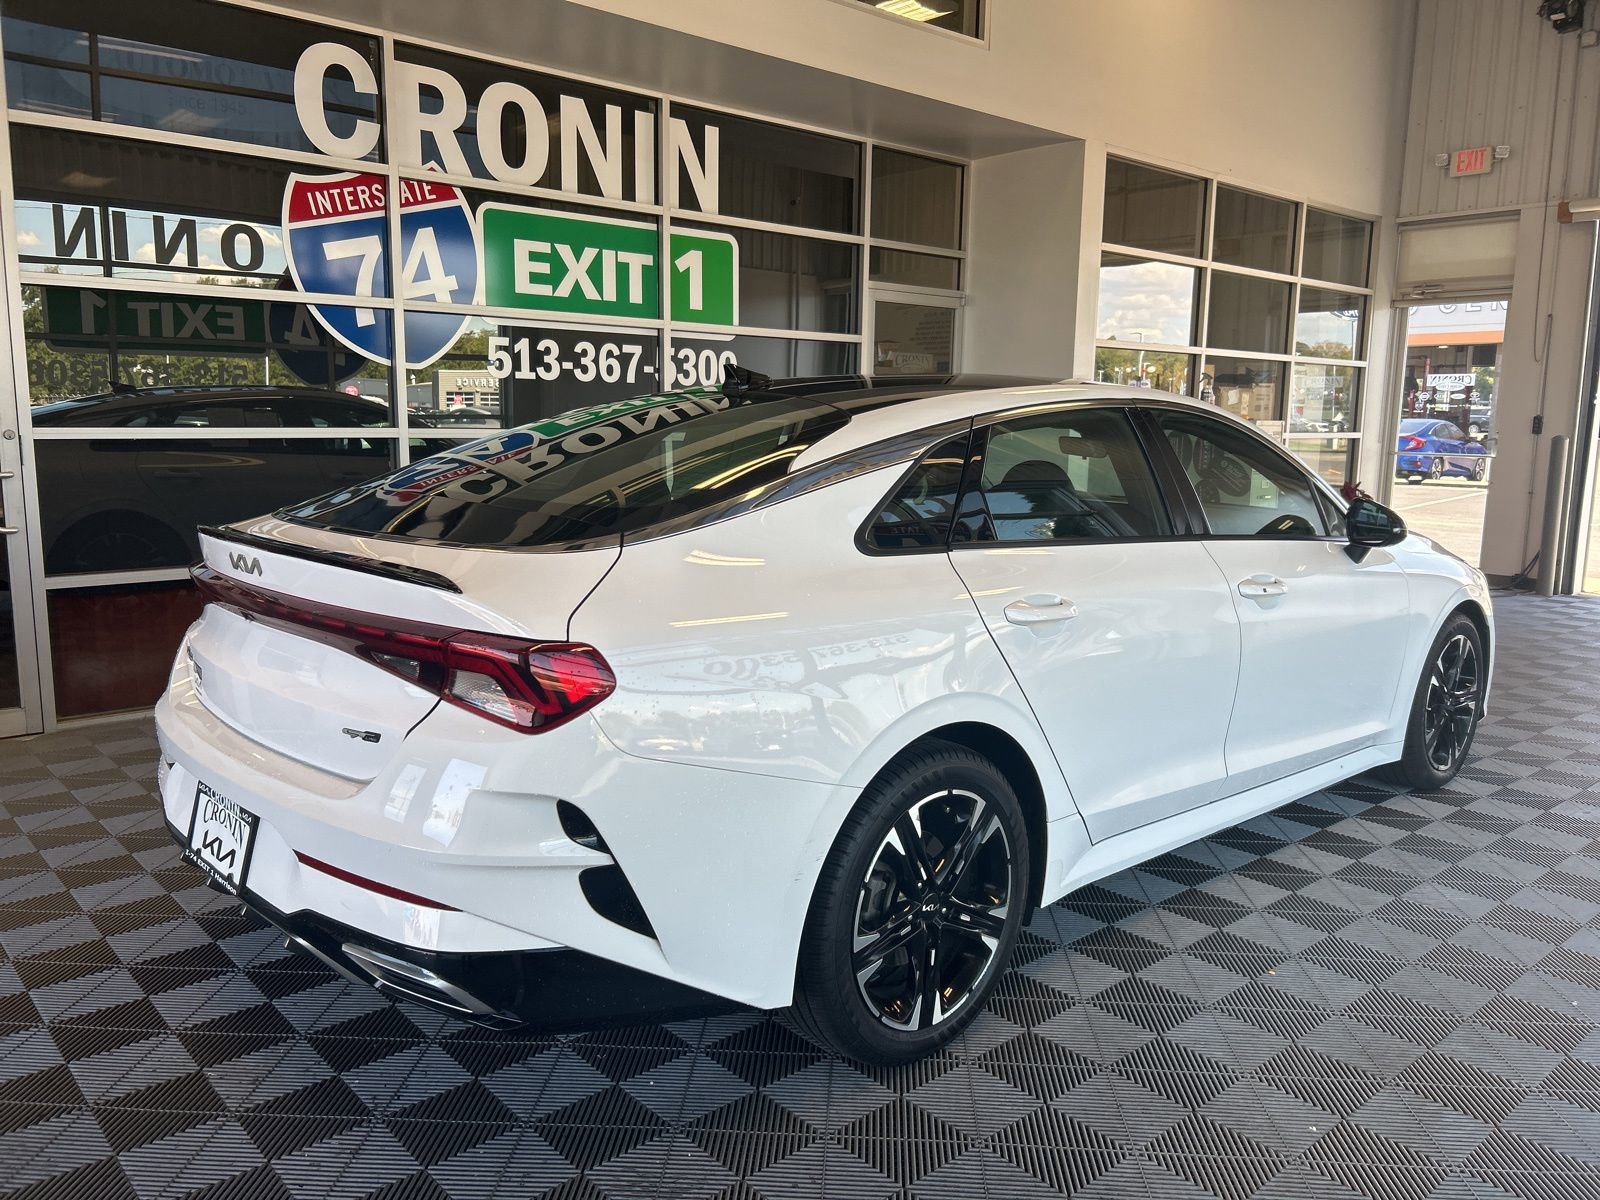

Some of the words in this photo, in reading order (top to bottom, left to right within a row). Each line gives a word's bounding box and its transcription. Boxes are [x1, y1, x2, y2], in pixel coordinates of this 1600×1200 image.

[294, 42, 719, 214] CRONIN
[1456, 148, 1488, 173] EXIT
[307, 180, 437, 216] INTERSATE
[323, 226, 459, 328] 74
[514, 238, 654, 305] EXIT
[674, 249, 703, 311] 1
[229, 551, 263, 577] KIA
[203, 799, 247, 849] CRONIN
[202, 829, 236, 869] KIA
[197, 859, 210, 872] EXIT
[214, 873, 237, 895] Harrison
